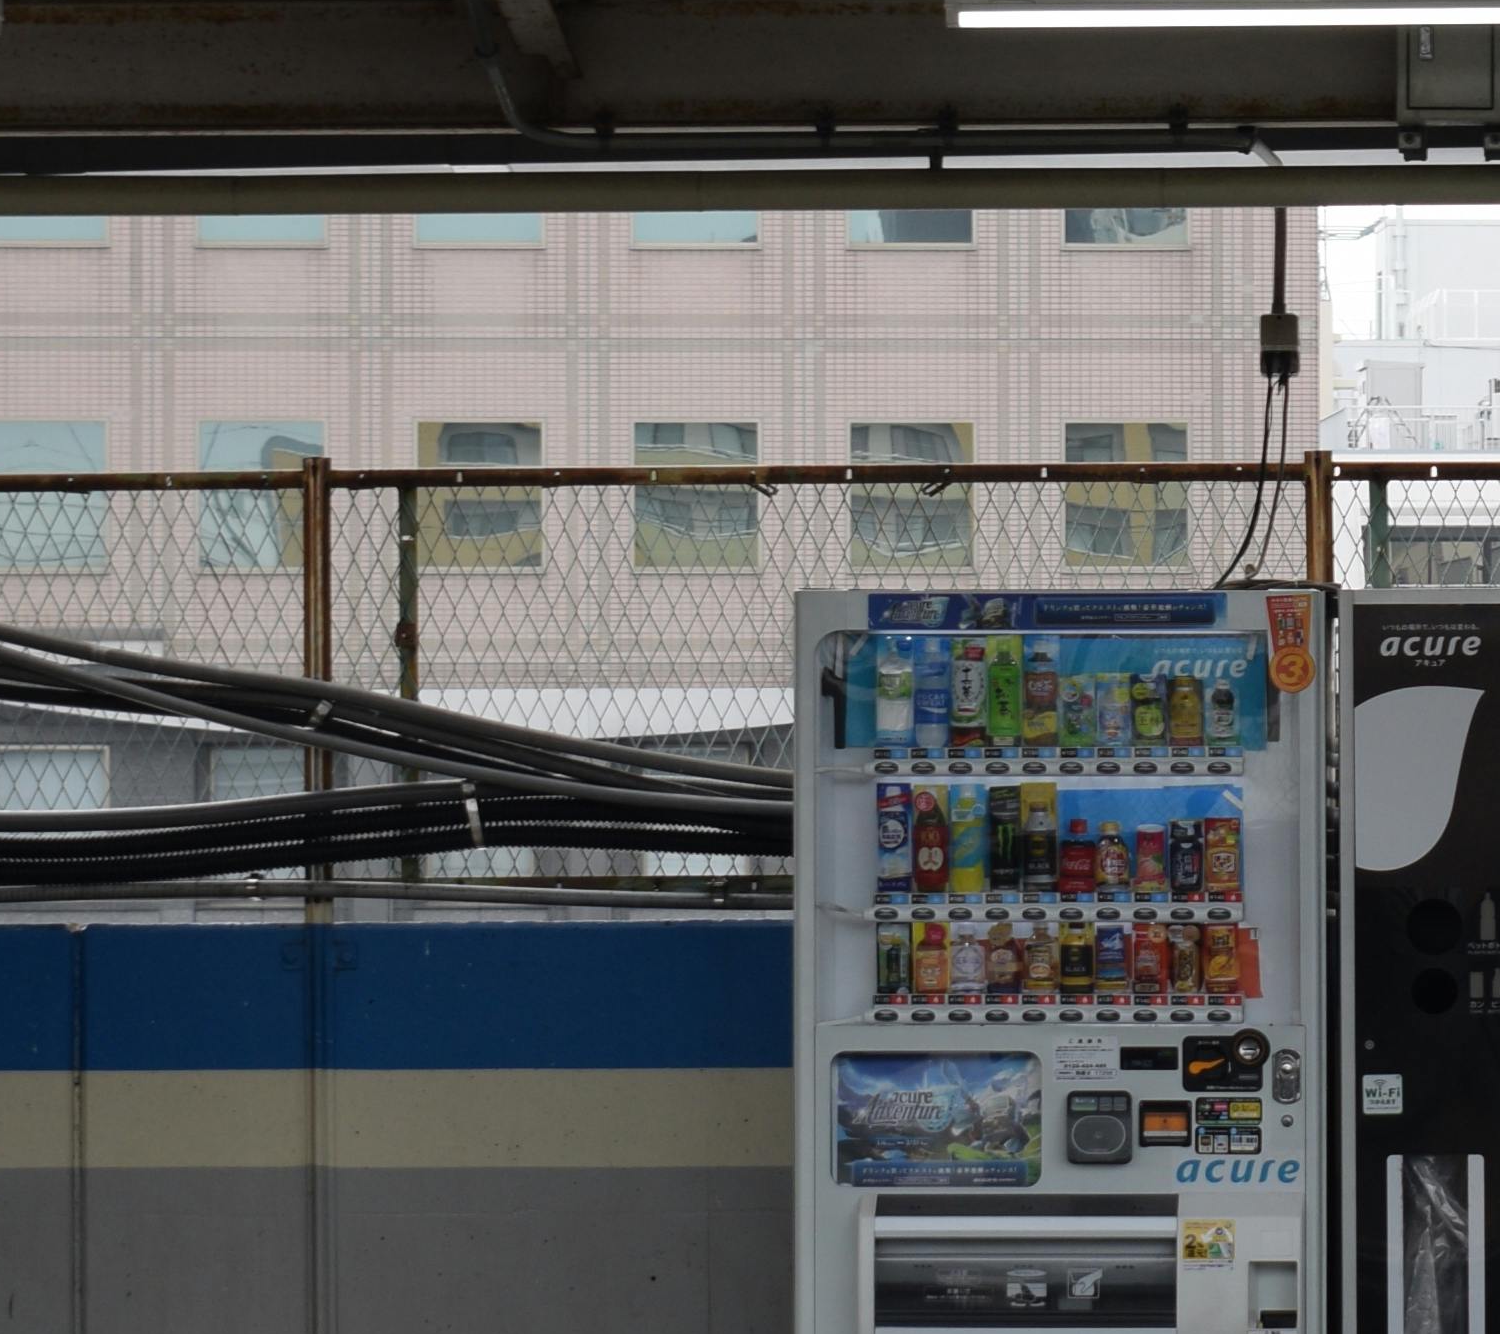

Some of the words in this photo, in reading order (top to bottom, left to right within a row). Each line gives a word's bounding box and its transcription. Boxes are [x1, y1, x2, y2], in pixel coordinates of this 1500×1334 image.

[1380, 636, 1482, 656] acure
[1152, 659, 1248, 679] acure
[1280, 657, 1305, 681] 3
[1364, 1087, 1400, 1098] Wi-Fi
[1176, 1158, 1300, 1183] acure
